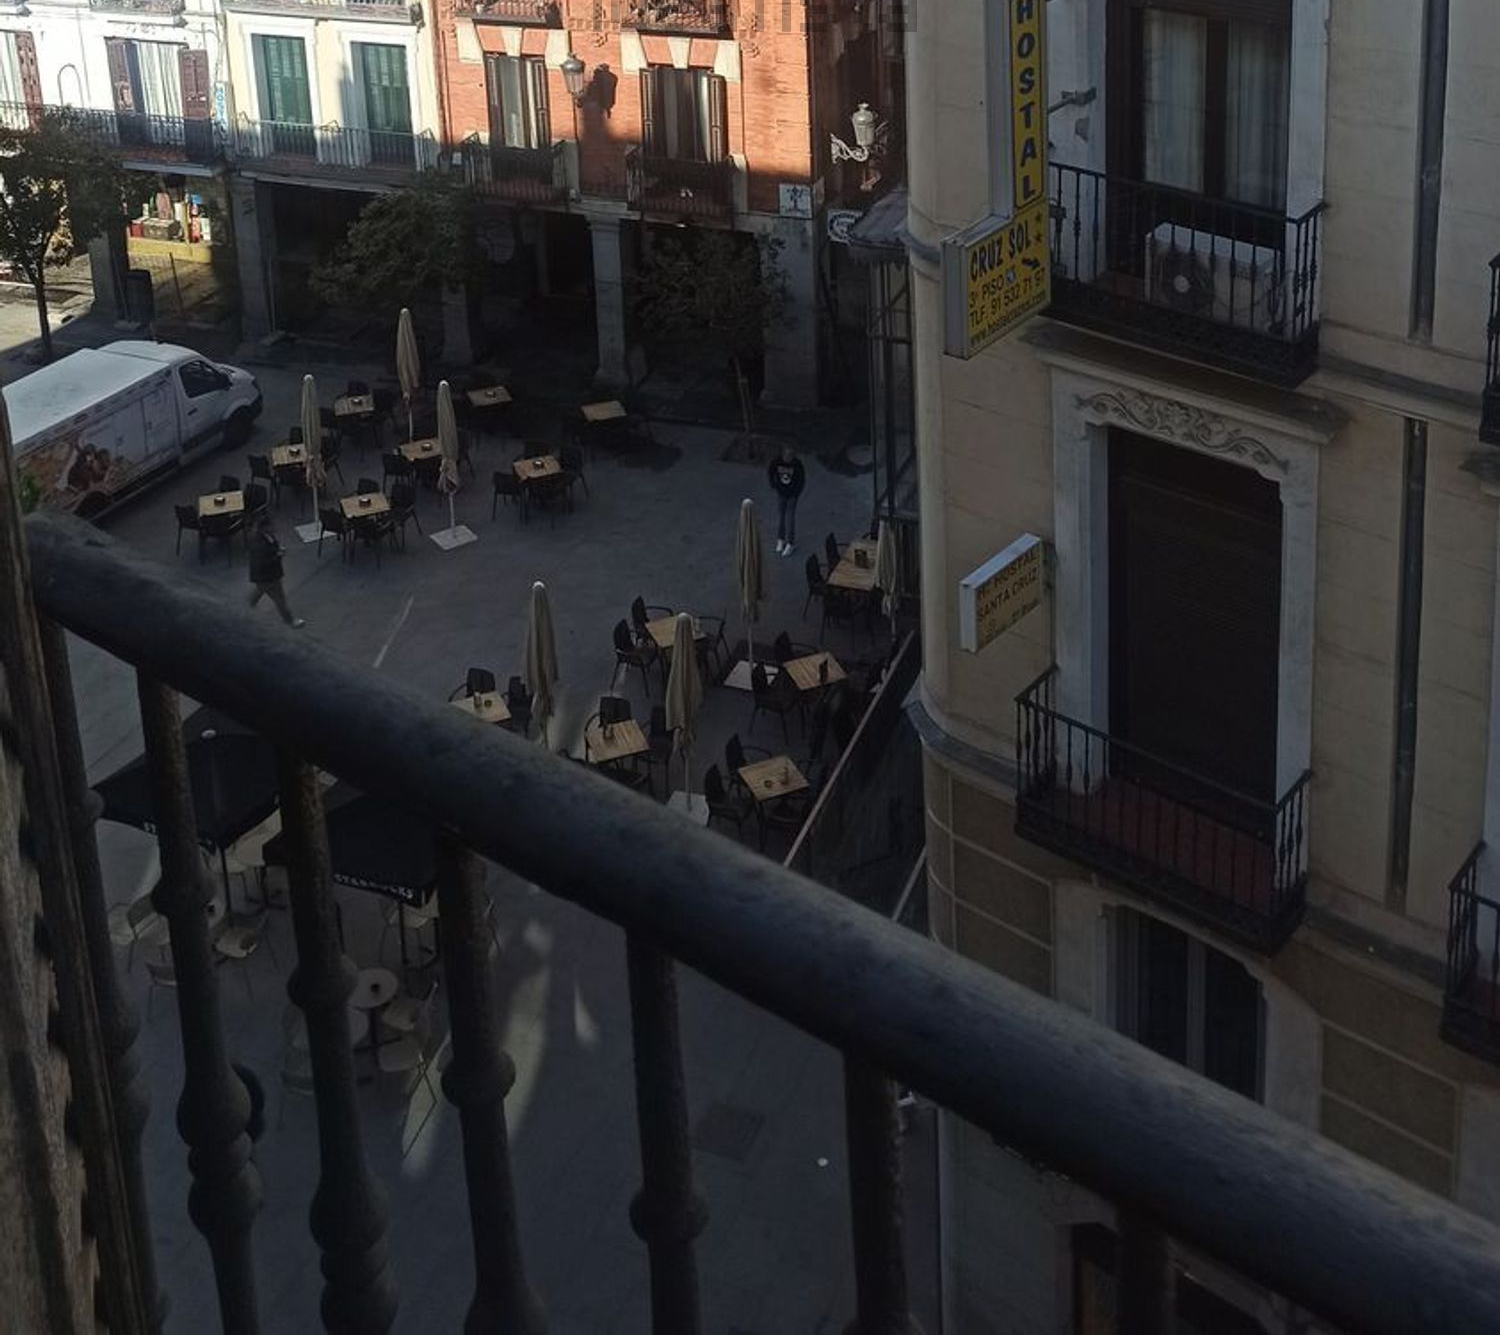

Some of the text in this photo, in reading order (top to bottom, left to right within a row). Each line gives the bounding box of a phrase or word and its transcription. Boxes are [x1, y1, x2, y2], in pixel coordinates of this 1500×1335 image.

[970, 219, 1032, 282] CRUZ SOL
[982, 274, 1005, 299] PISO
[978, 588, 1010, 622] SANTA
[1012, 566, 1038, 597] CRUZ
